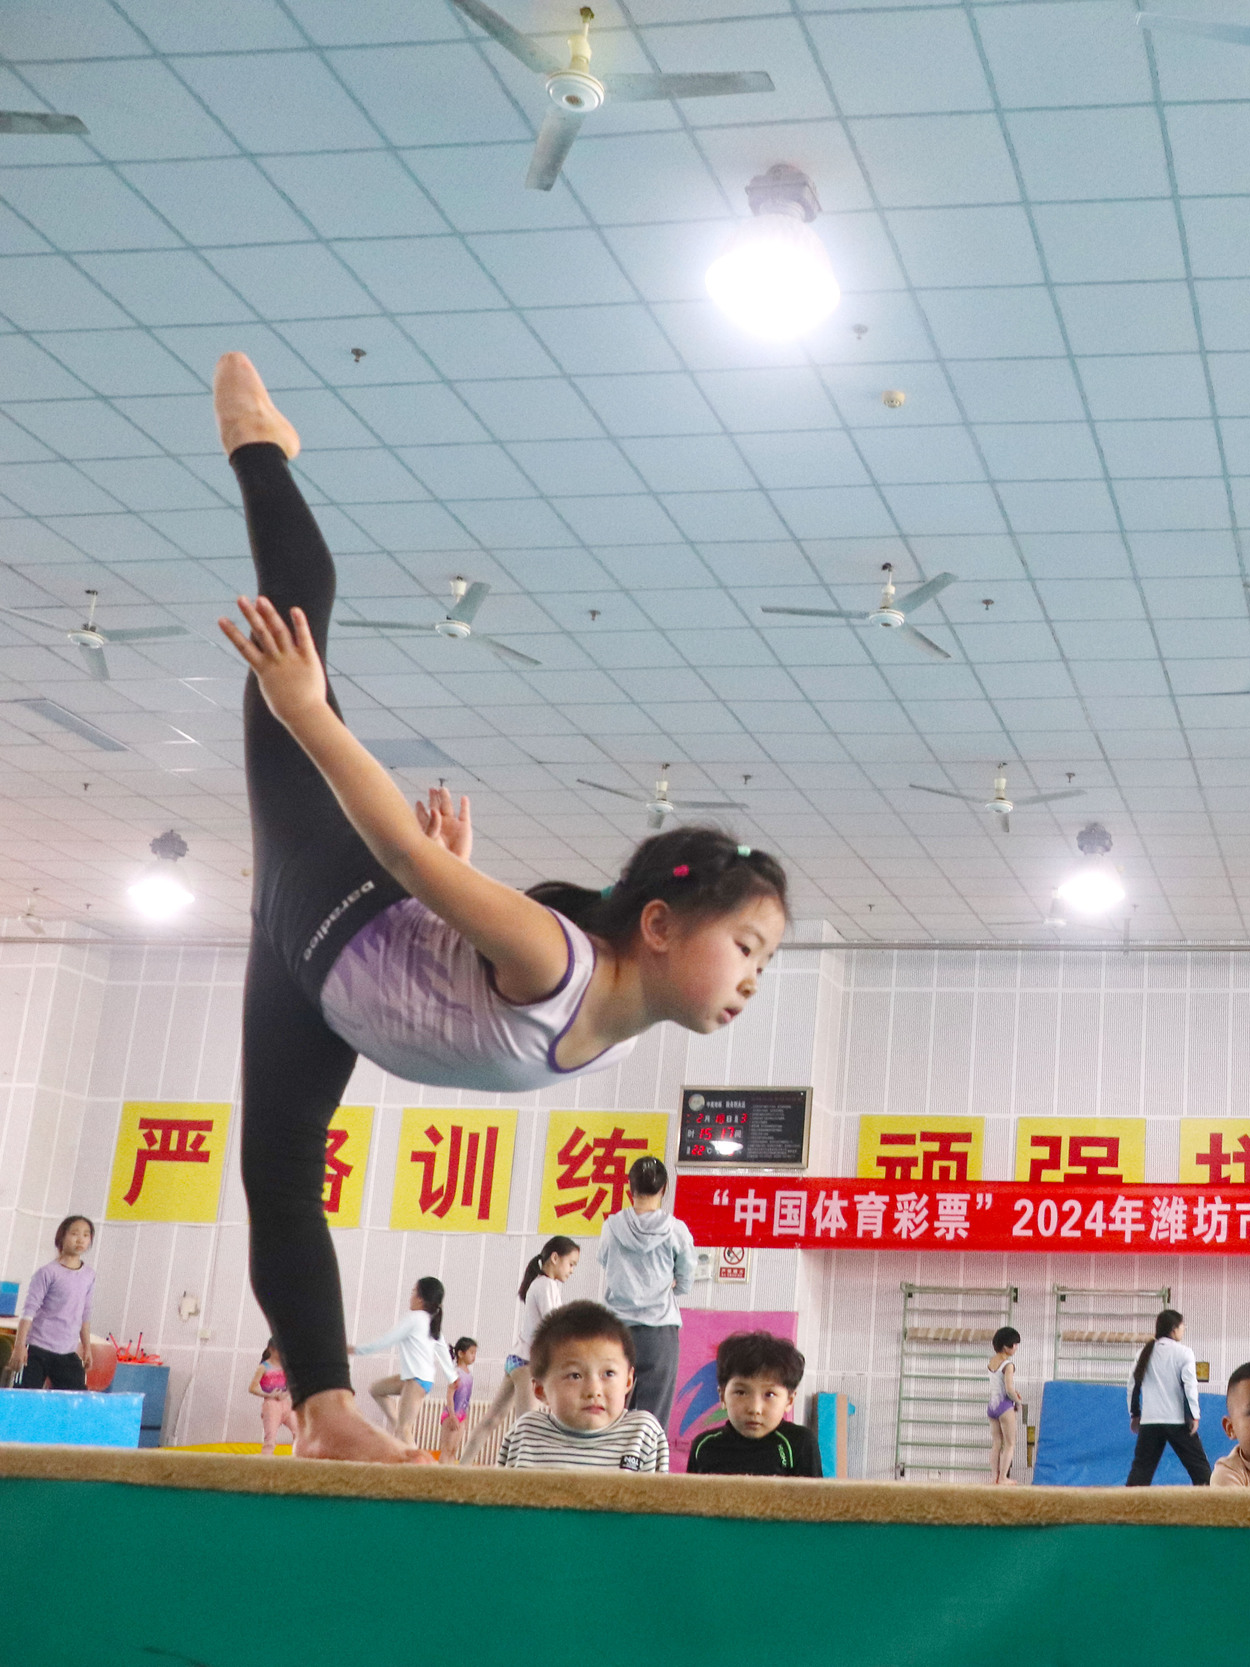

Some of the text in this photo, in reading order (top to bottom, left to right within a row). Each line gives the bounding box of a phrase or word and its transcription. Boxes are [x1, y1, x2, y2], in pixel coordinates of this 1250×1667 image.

[713, 1189, 992, 1240] “中国体育彩票”
